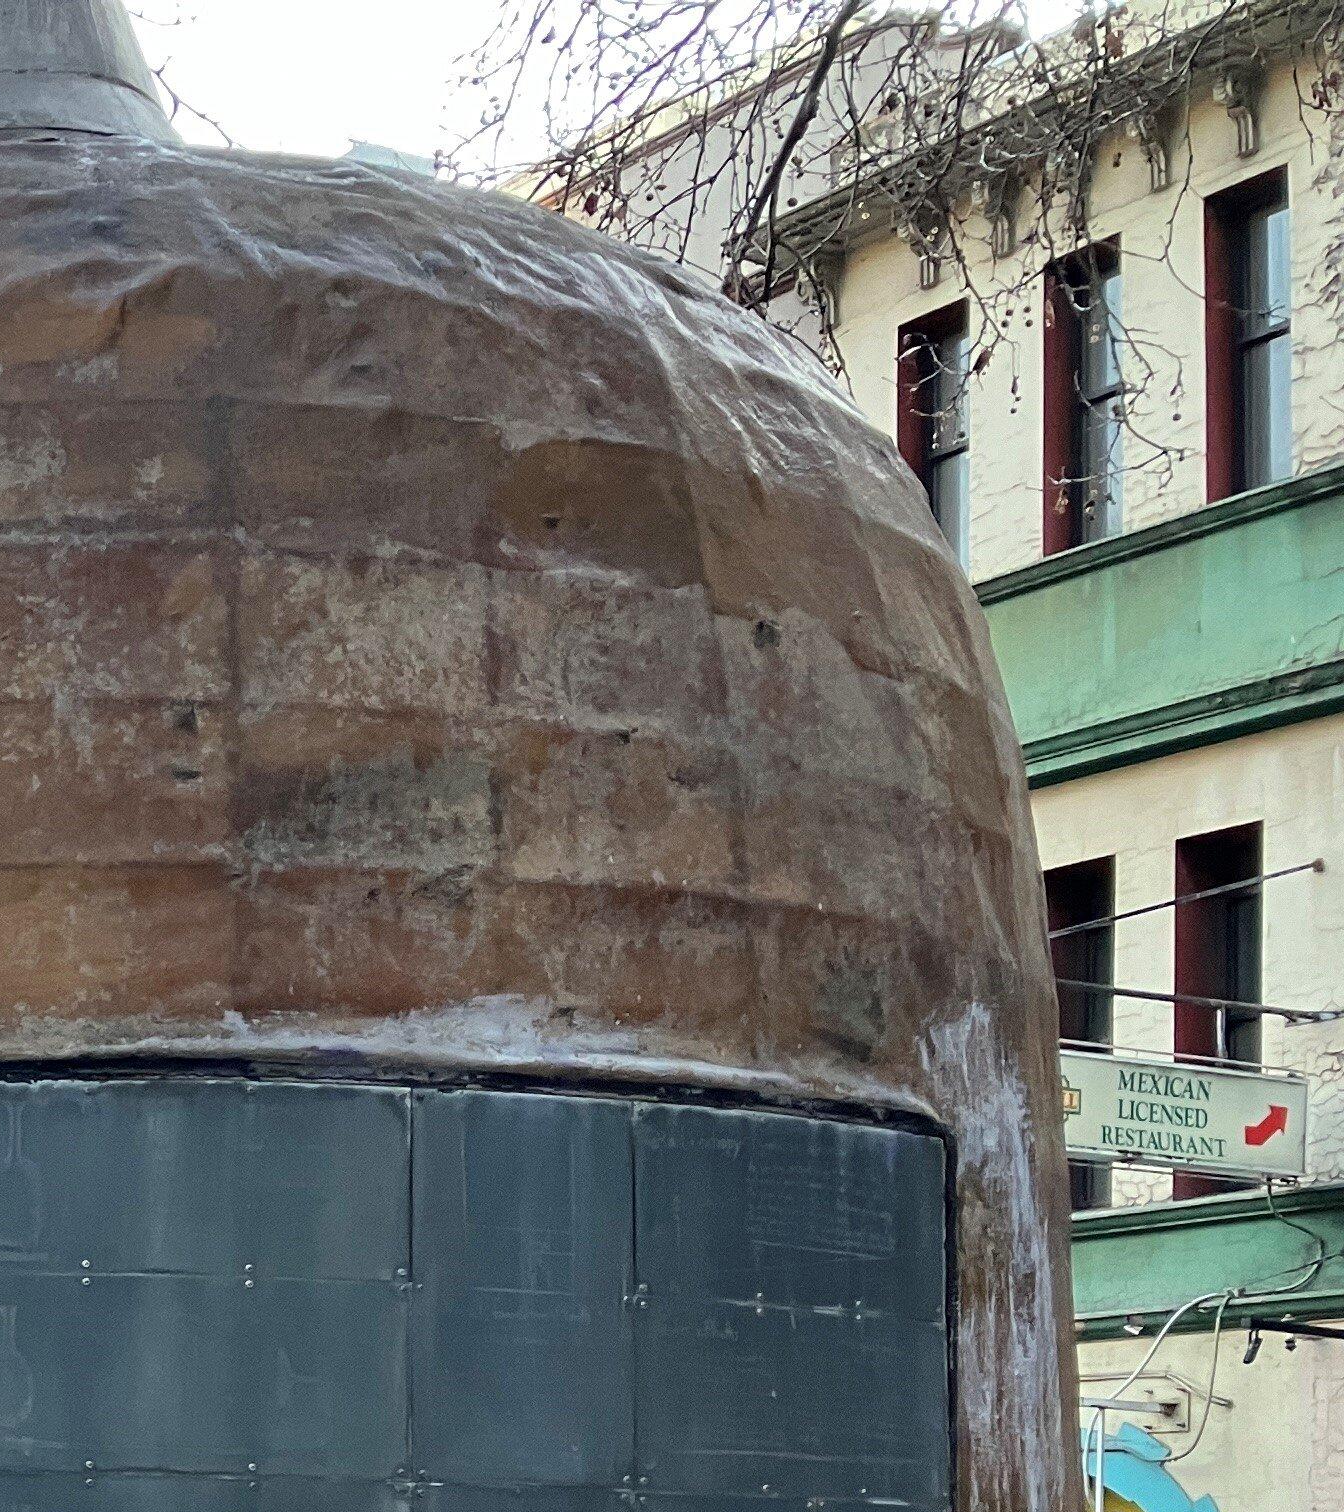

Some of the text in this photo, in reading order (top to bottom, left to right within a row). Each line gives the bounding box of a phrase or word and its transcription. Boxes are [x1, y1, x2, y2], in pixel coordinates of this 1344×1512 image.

[1118, 1070, 1212, 1101] MEXICAN
[1117, 1099, 1208, 1129] LICENSED
[1102, 1125, 1226, 1157] RESTAURANT
